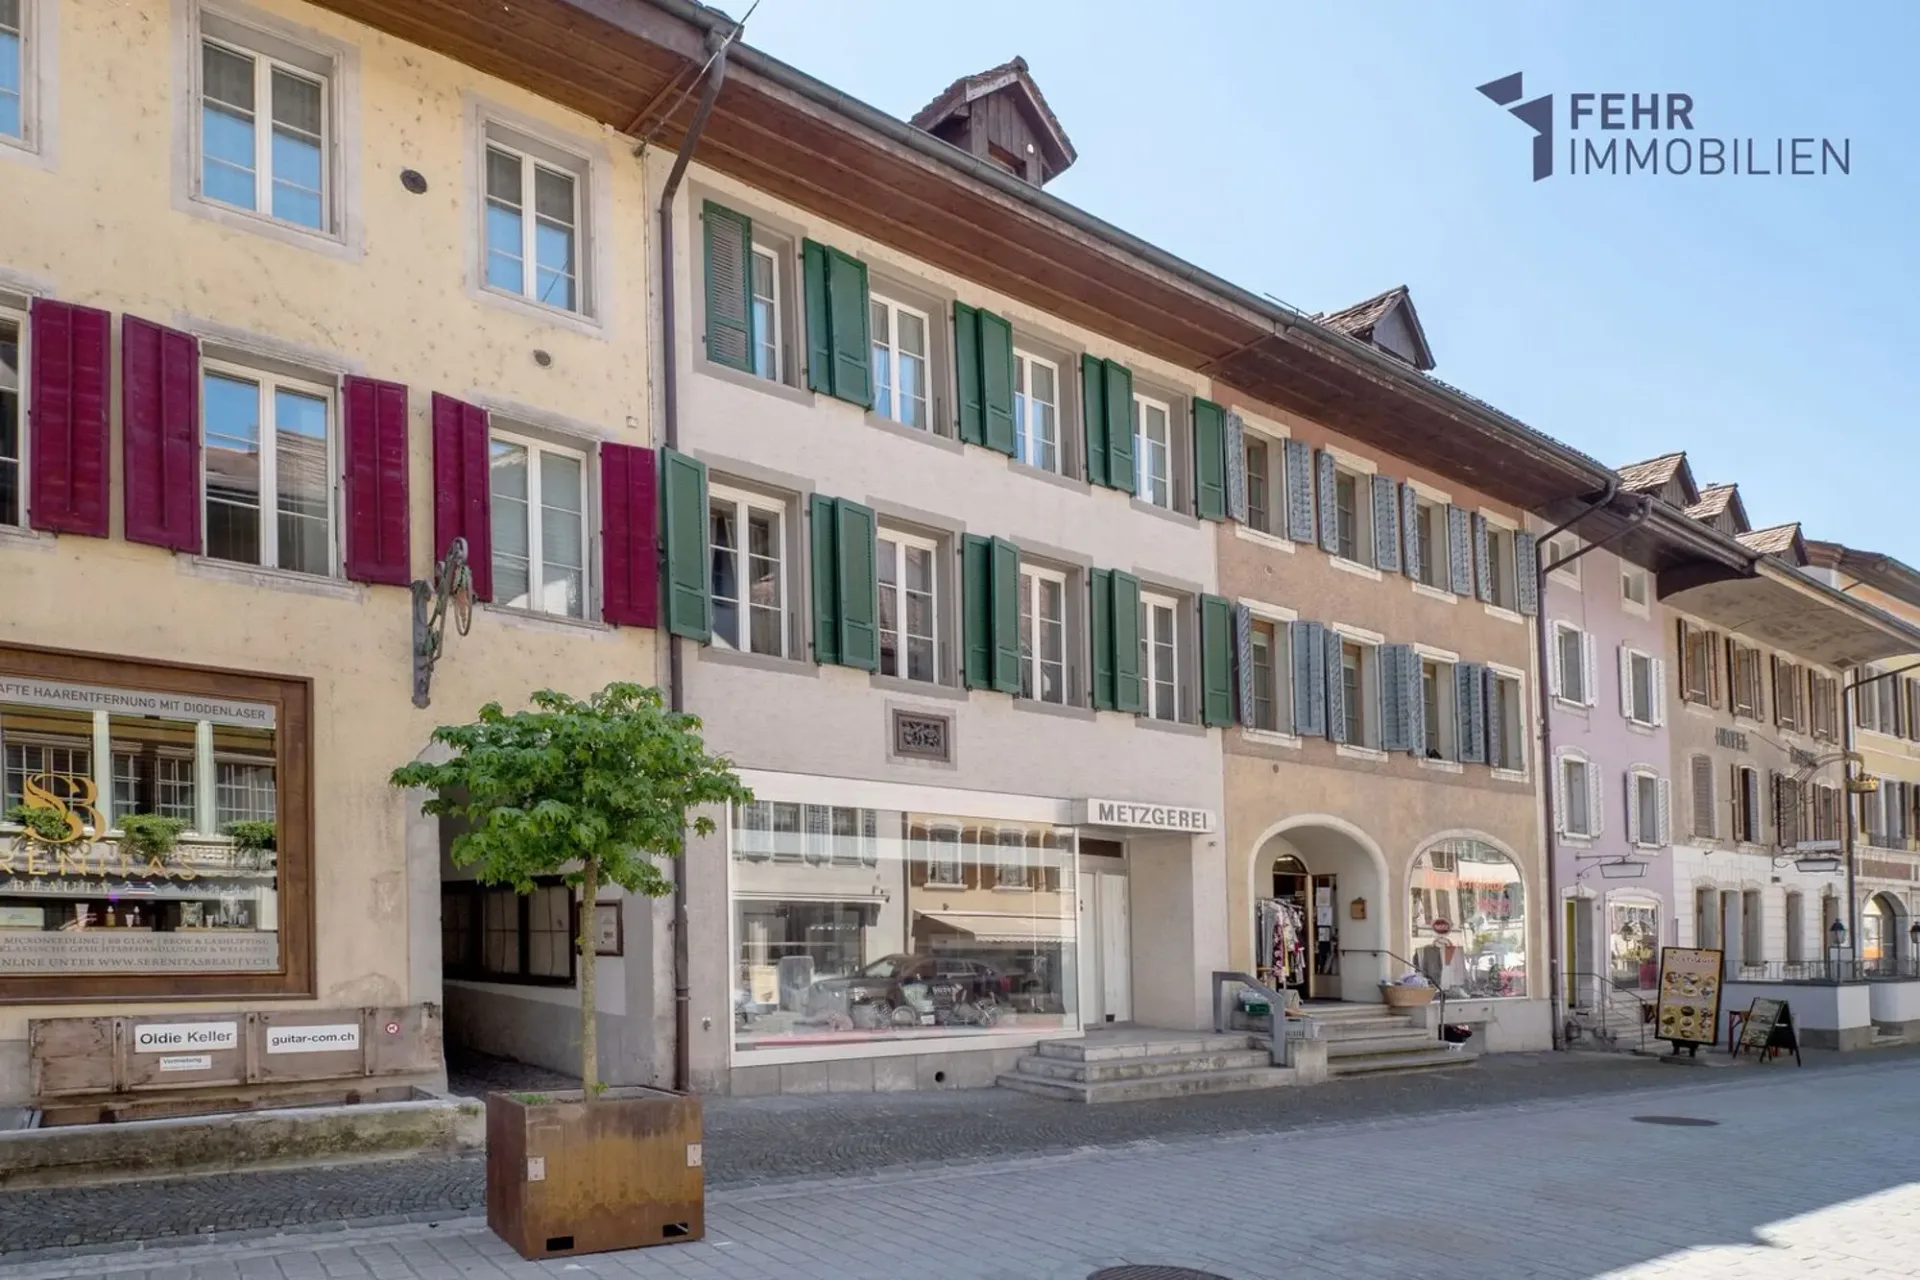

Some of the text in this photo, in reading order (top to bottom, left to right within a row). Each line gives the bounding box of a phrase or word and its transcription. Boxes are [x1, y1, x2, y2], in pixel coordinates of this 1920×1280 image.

[33, 686, 157, 709] HAARENTFERNUNG
[160, 699, 181, 711] MIT
[183, 702, 266, 720] DIODENLASER
[1098, 803, 1207, 830] METZGEREI
[13, 881, 113, 894] BEAUTY
[140, 1030, 233, 1045] Oldie Keller
[271, 1032, 355, 1046] guitar-com.ch
